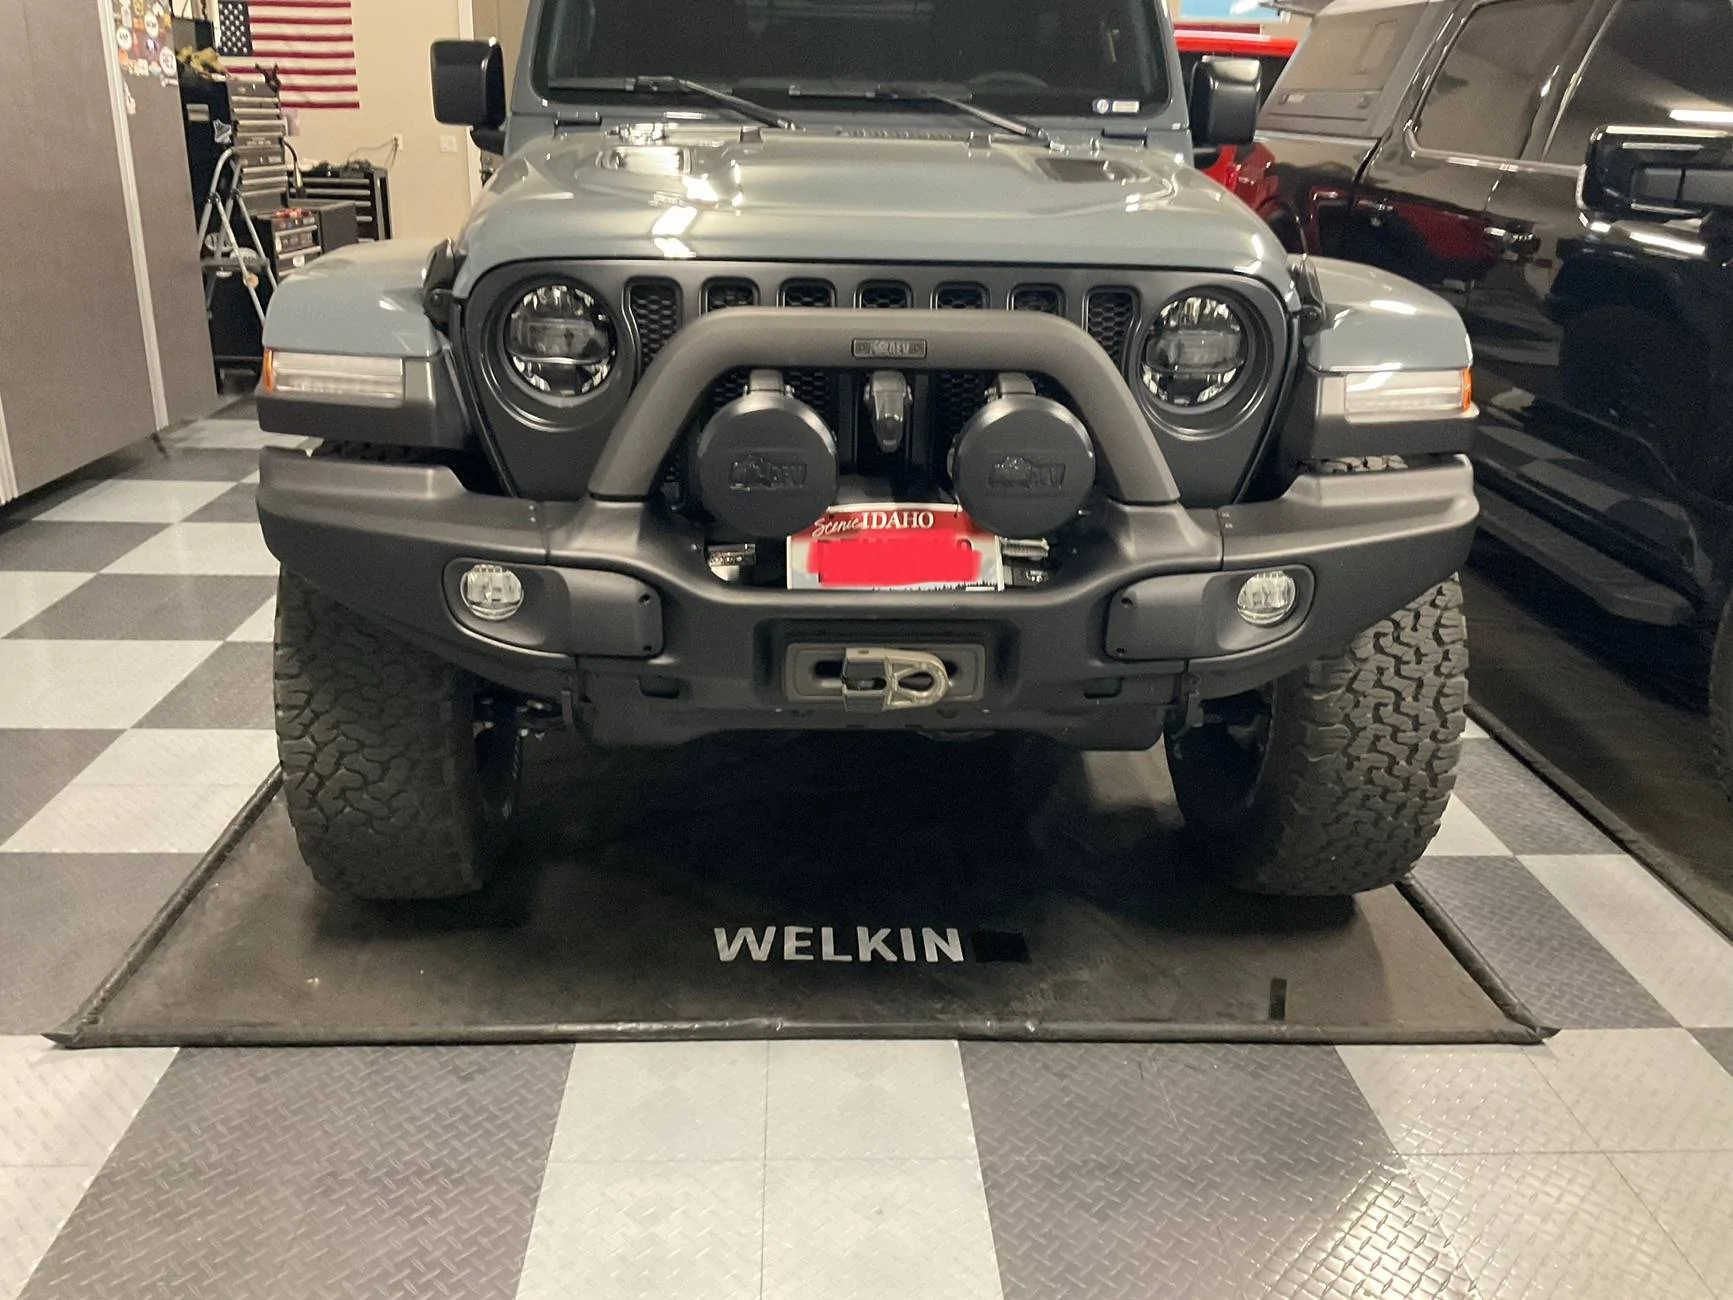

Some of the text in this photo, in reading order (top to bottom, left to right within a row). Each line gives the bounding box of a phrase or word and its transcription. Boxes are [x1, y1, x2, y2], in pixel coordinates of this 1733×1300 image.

[812, 512, 934, 537] Scenic IDAHO
[714, 926, 965, 962] WELKIN
